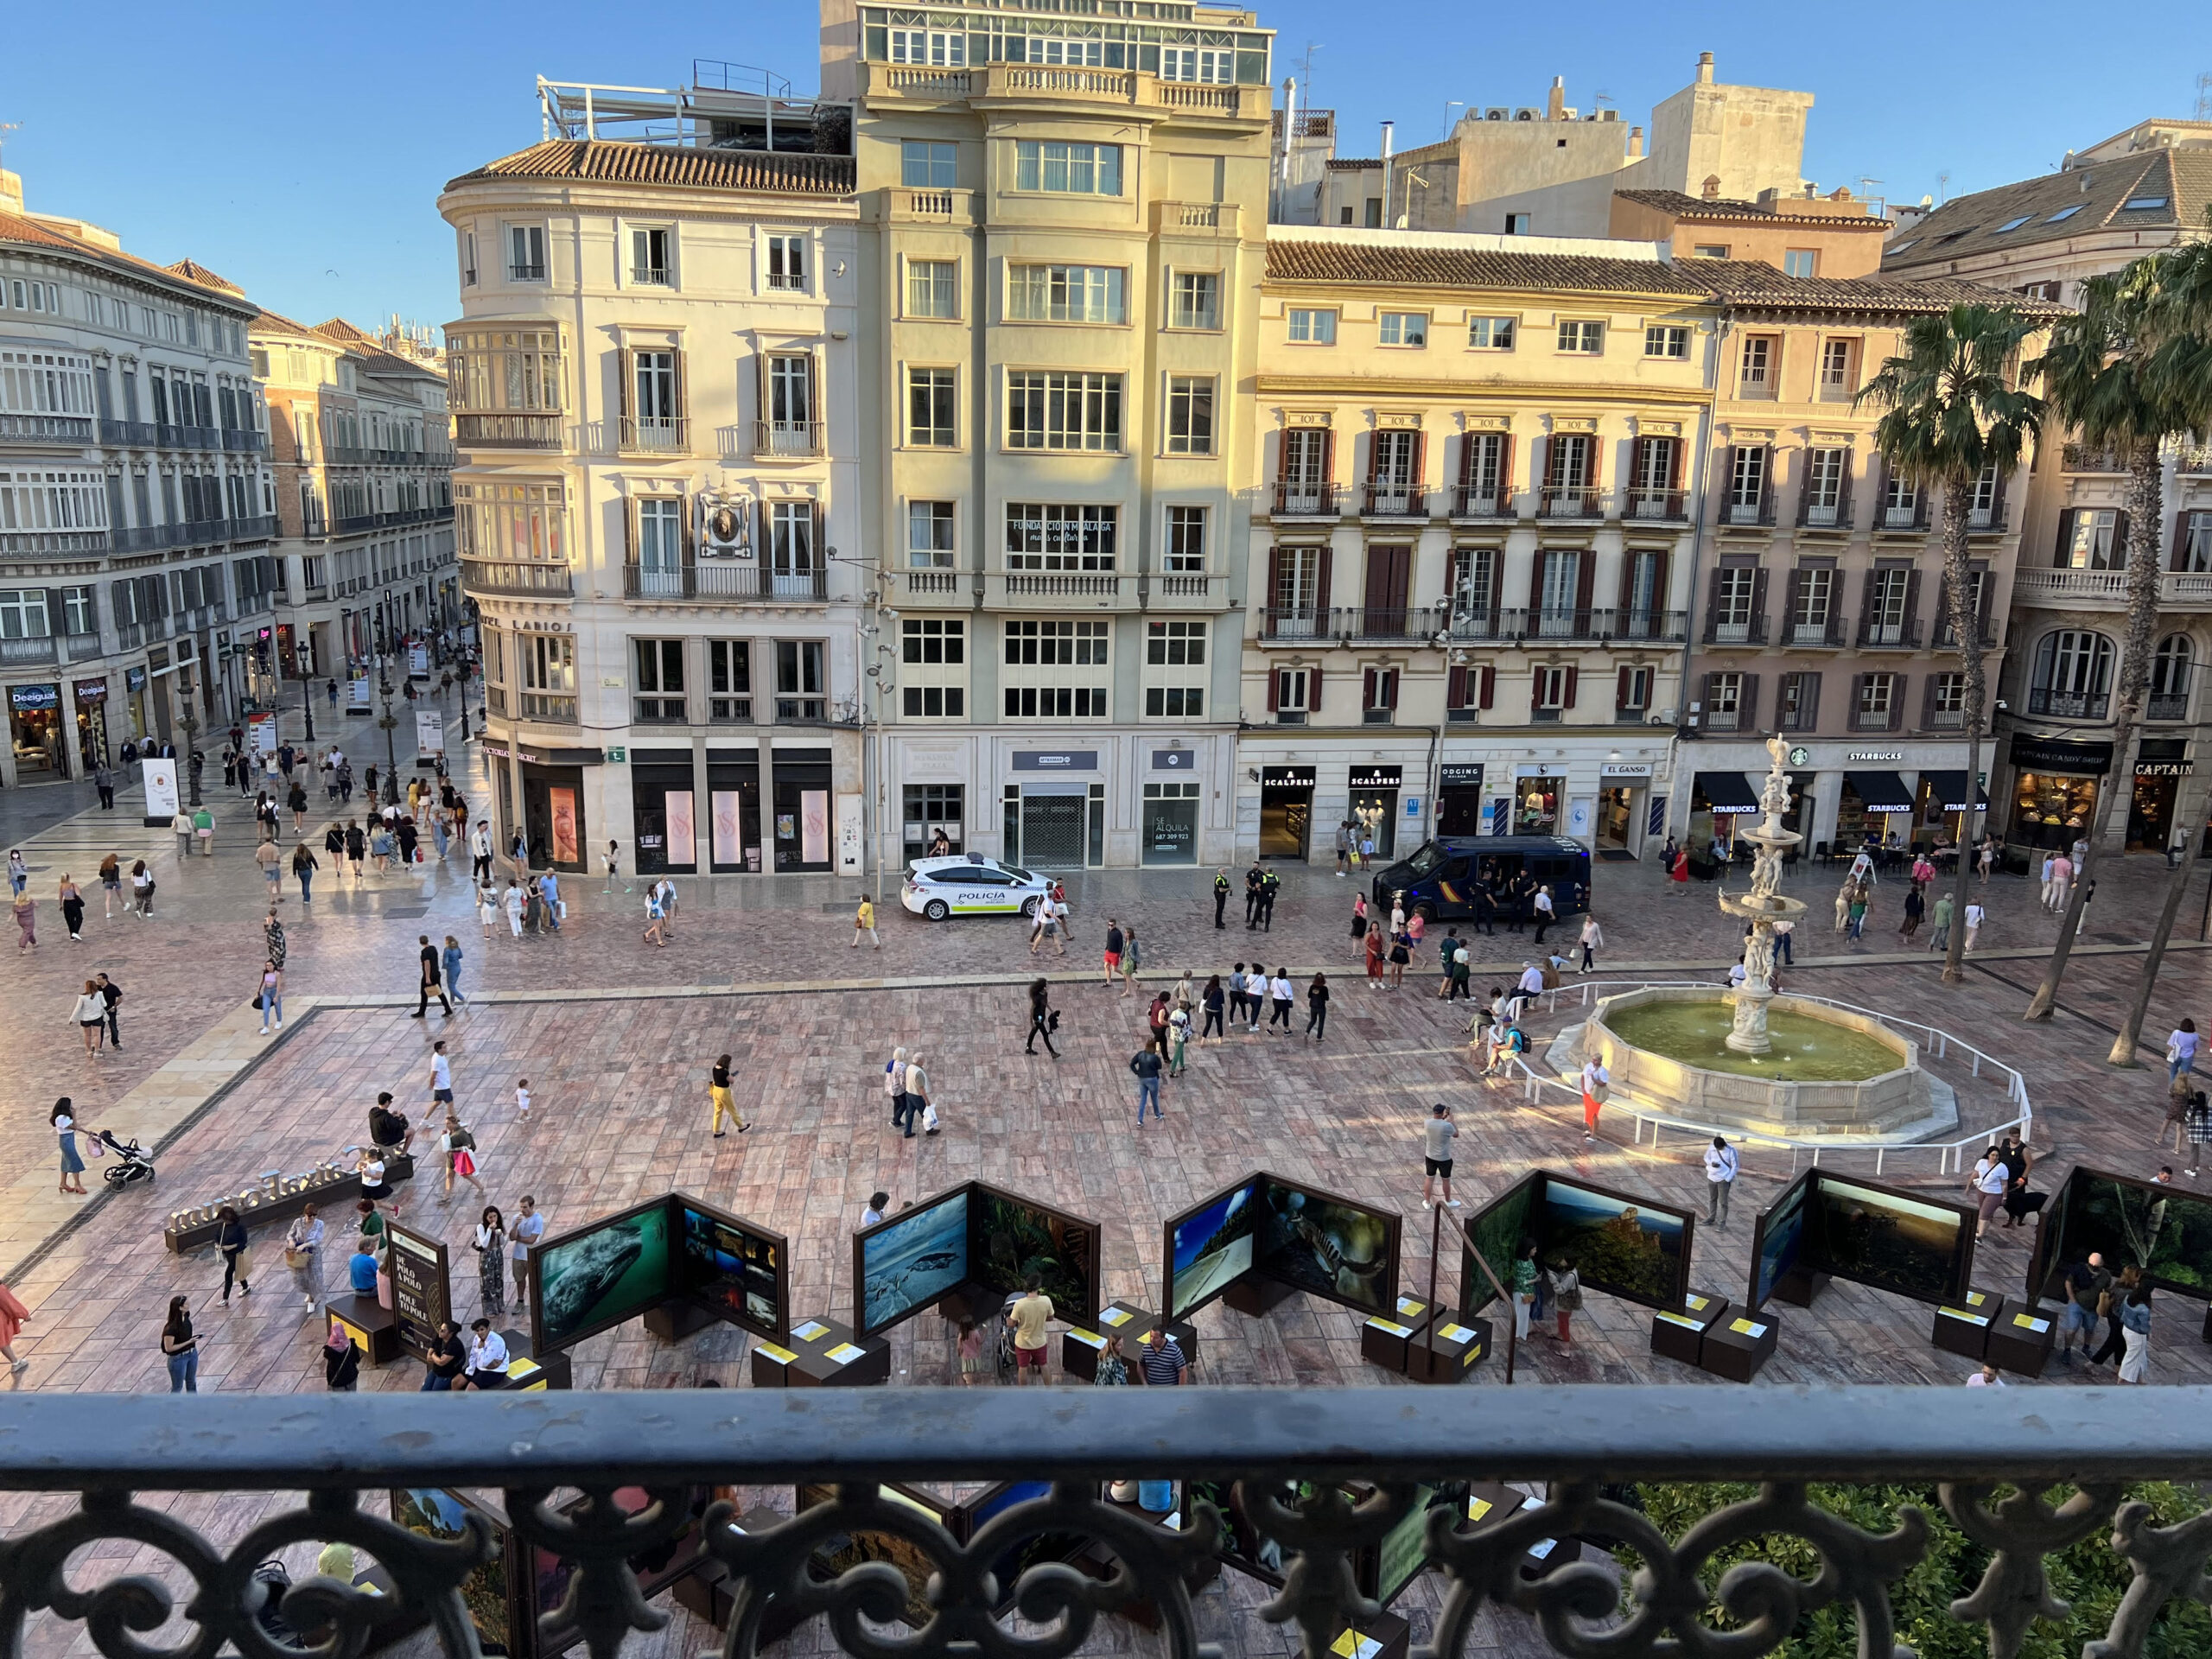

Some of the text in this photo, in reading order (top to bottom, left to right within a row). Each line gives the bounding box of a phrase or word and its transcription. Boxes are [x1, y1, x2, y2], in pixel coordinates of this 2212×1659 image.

[1013, 519, 1111, 531] FUNDACIÓN MÁLAGA
[1052, 531, 1089, 543] cultura
[512, 620, 572, 632] LARIOS
[517, 752, 537, 762] SECRET
[2051, 753, 2082, 762] CANDY
[2082, 756, 2105, 765] SHOP
[2135, 764, 2194, 775] CAPTAIN
[1155, 823, 1189, 832] ALQUILA
[958, 891, 1006, 899] POLICÍA
[396, 1254, 406, 1266] DE
[397, 1262, 416, 1279] POLO
[397, 1271, 403, 1281] A
[403, 1274, 422, 1291] POLO
[398, 1291, 417, 1307] POLE
[399, 1300, 410, 1312] TO
[410, 1306, 429, 1322] POLE
